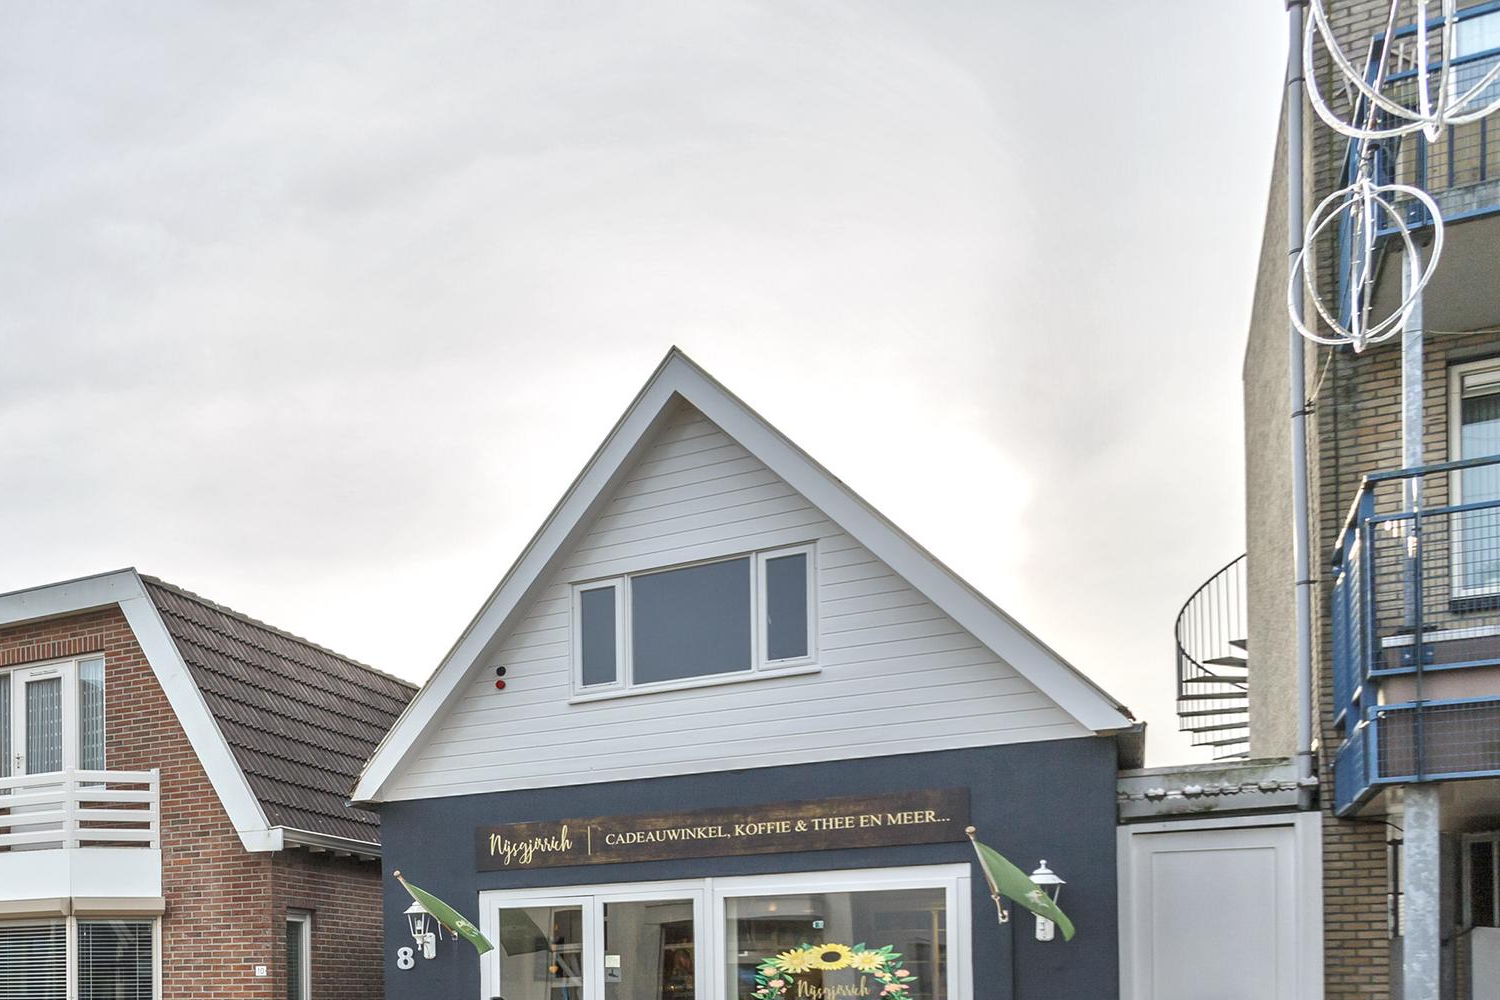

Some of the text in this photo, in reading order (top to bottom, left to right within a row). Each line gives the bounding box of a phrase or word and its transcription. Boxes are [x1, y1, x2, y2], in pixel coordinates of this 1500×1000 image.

[605, 810, 950, 845] CADEAUWINKEL, KOFFIE & THEE EN MEER...
[397, 946, 415, 970] 8
